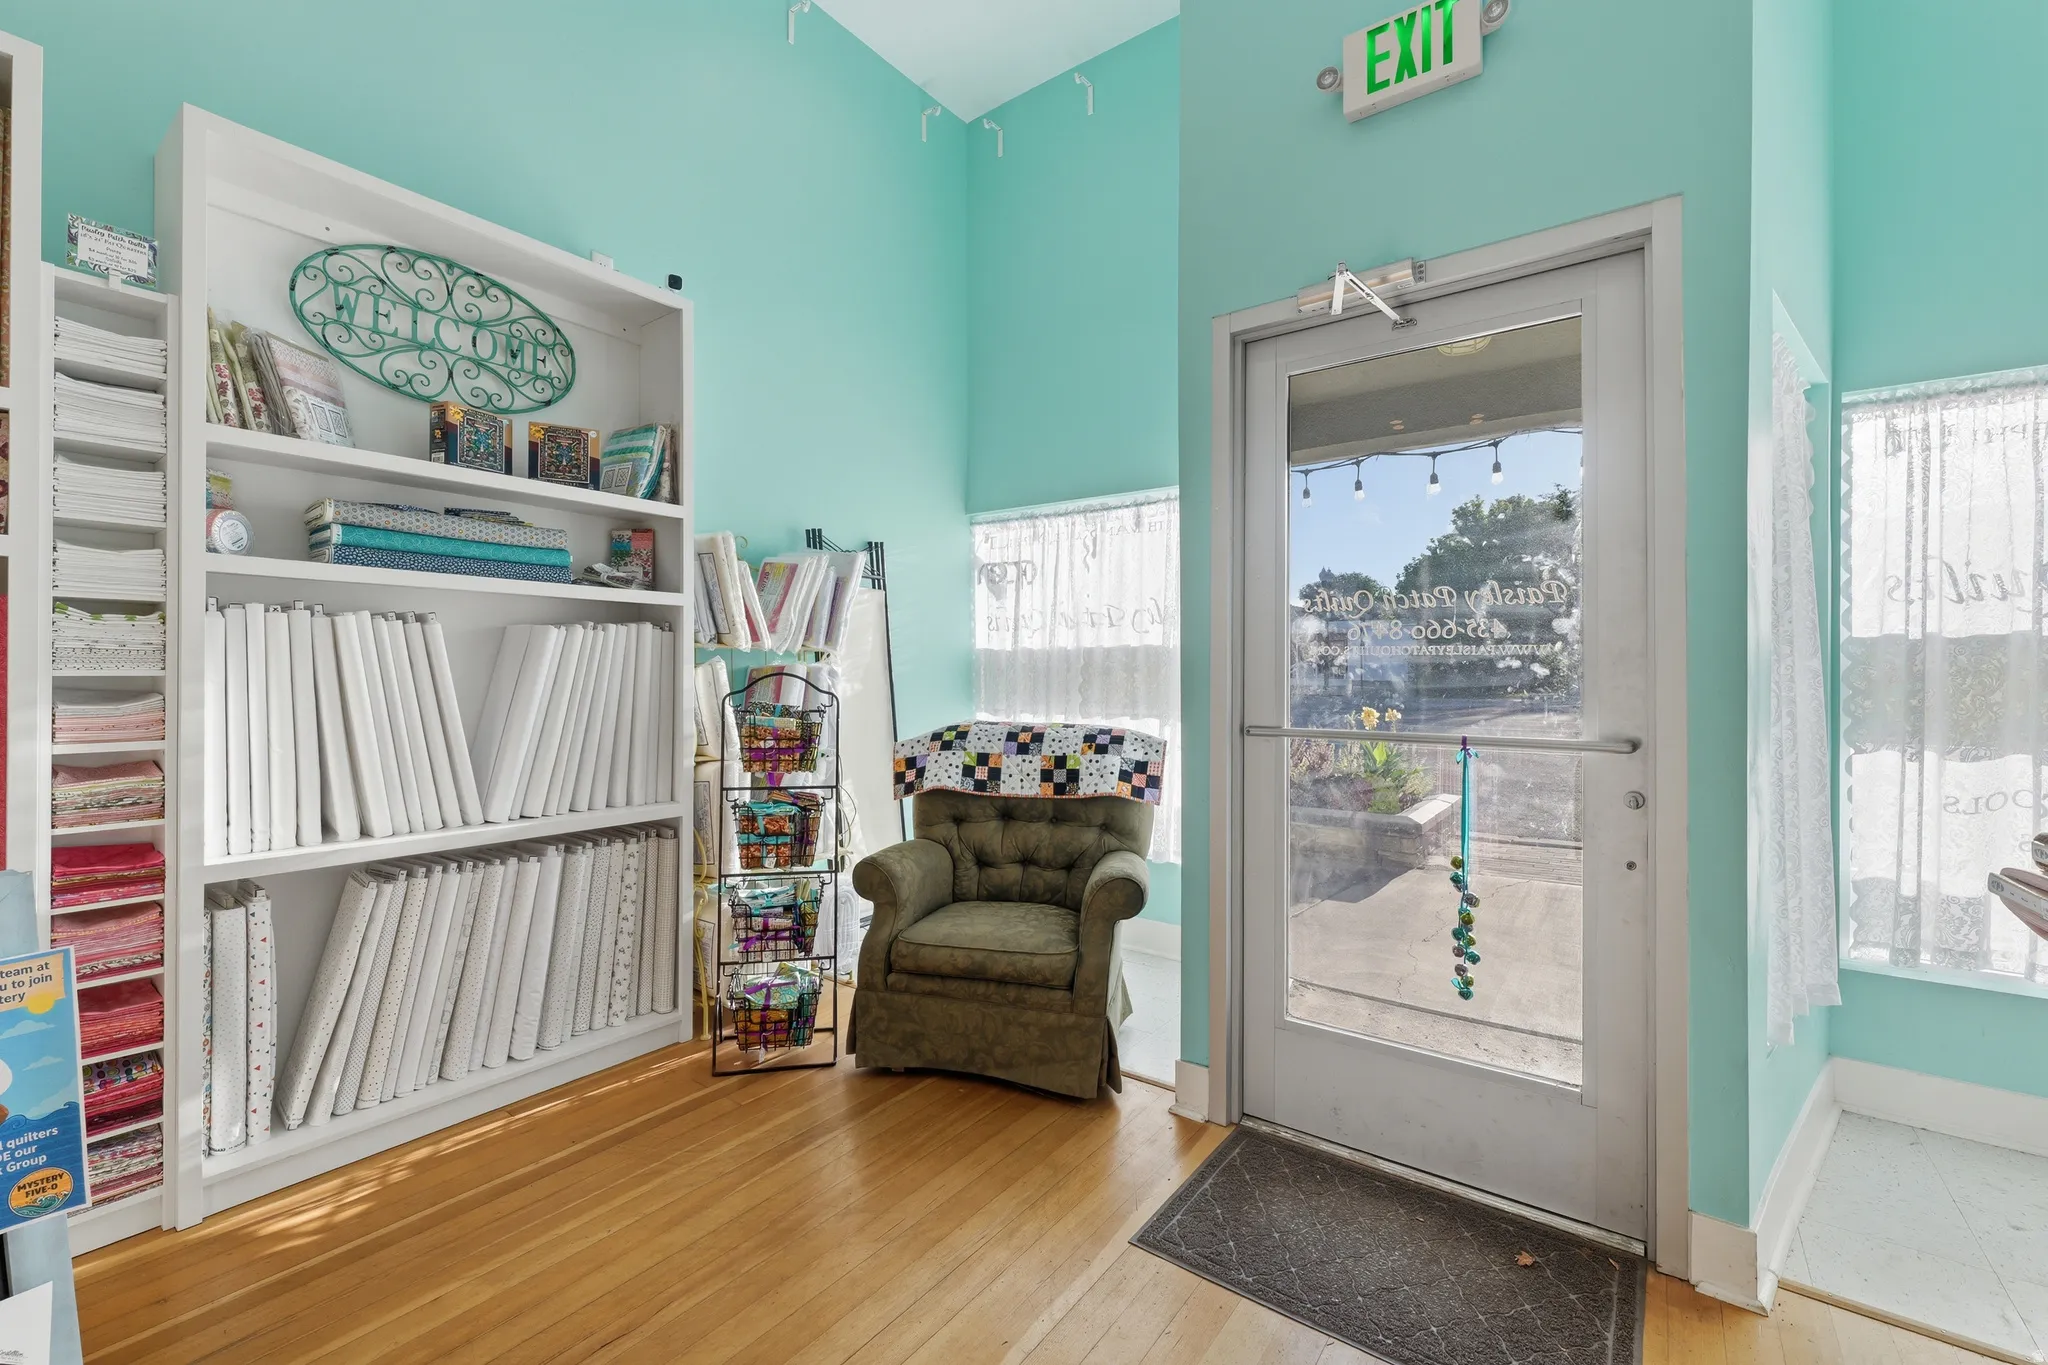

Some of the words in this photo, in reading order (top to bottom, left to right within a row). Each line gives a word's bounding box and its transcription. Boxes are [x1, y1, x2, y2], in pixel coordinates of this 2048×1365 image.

[1366, 0, 1460, 95] EXIT
[332, 284, 553, 377] WELCOME
[0, 966, 33, 979] team
[36, 961, 50, 972] at
[11, 980, 25, 989] to
[28, 974, 53, 988] join
[6, 1127, 59, 1149] quilters
[15, 1145, 38, 1158] our
[6, 1154, 47, 1173] Group
[17, 1172, 65, 1193] MYSTERY
